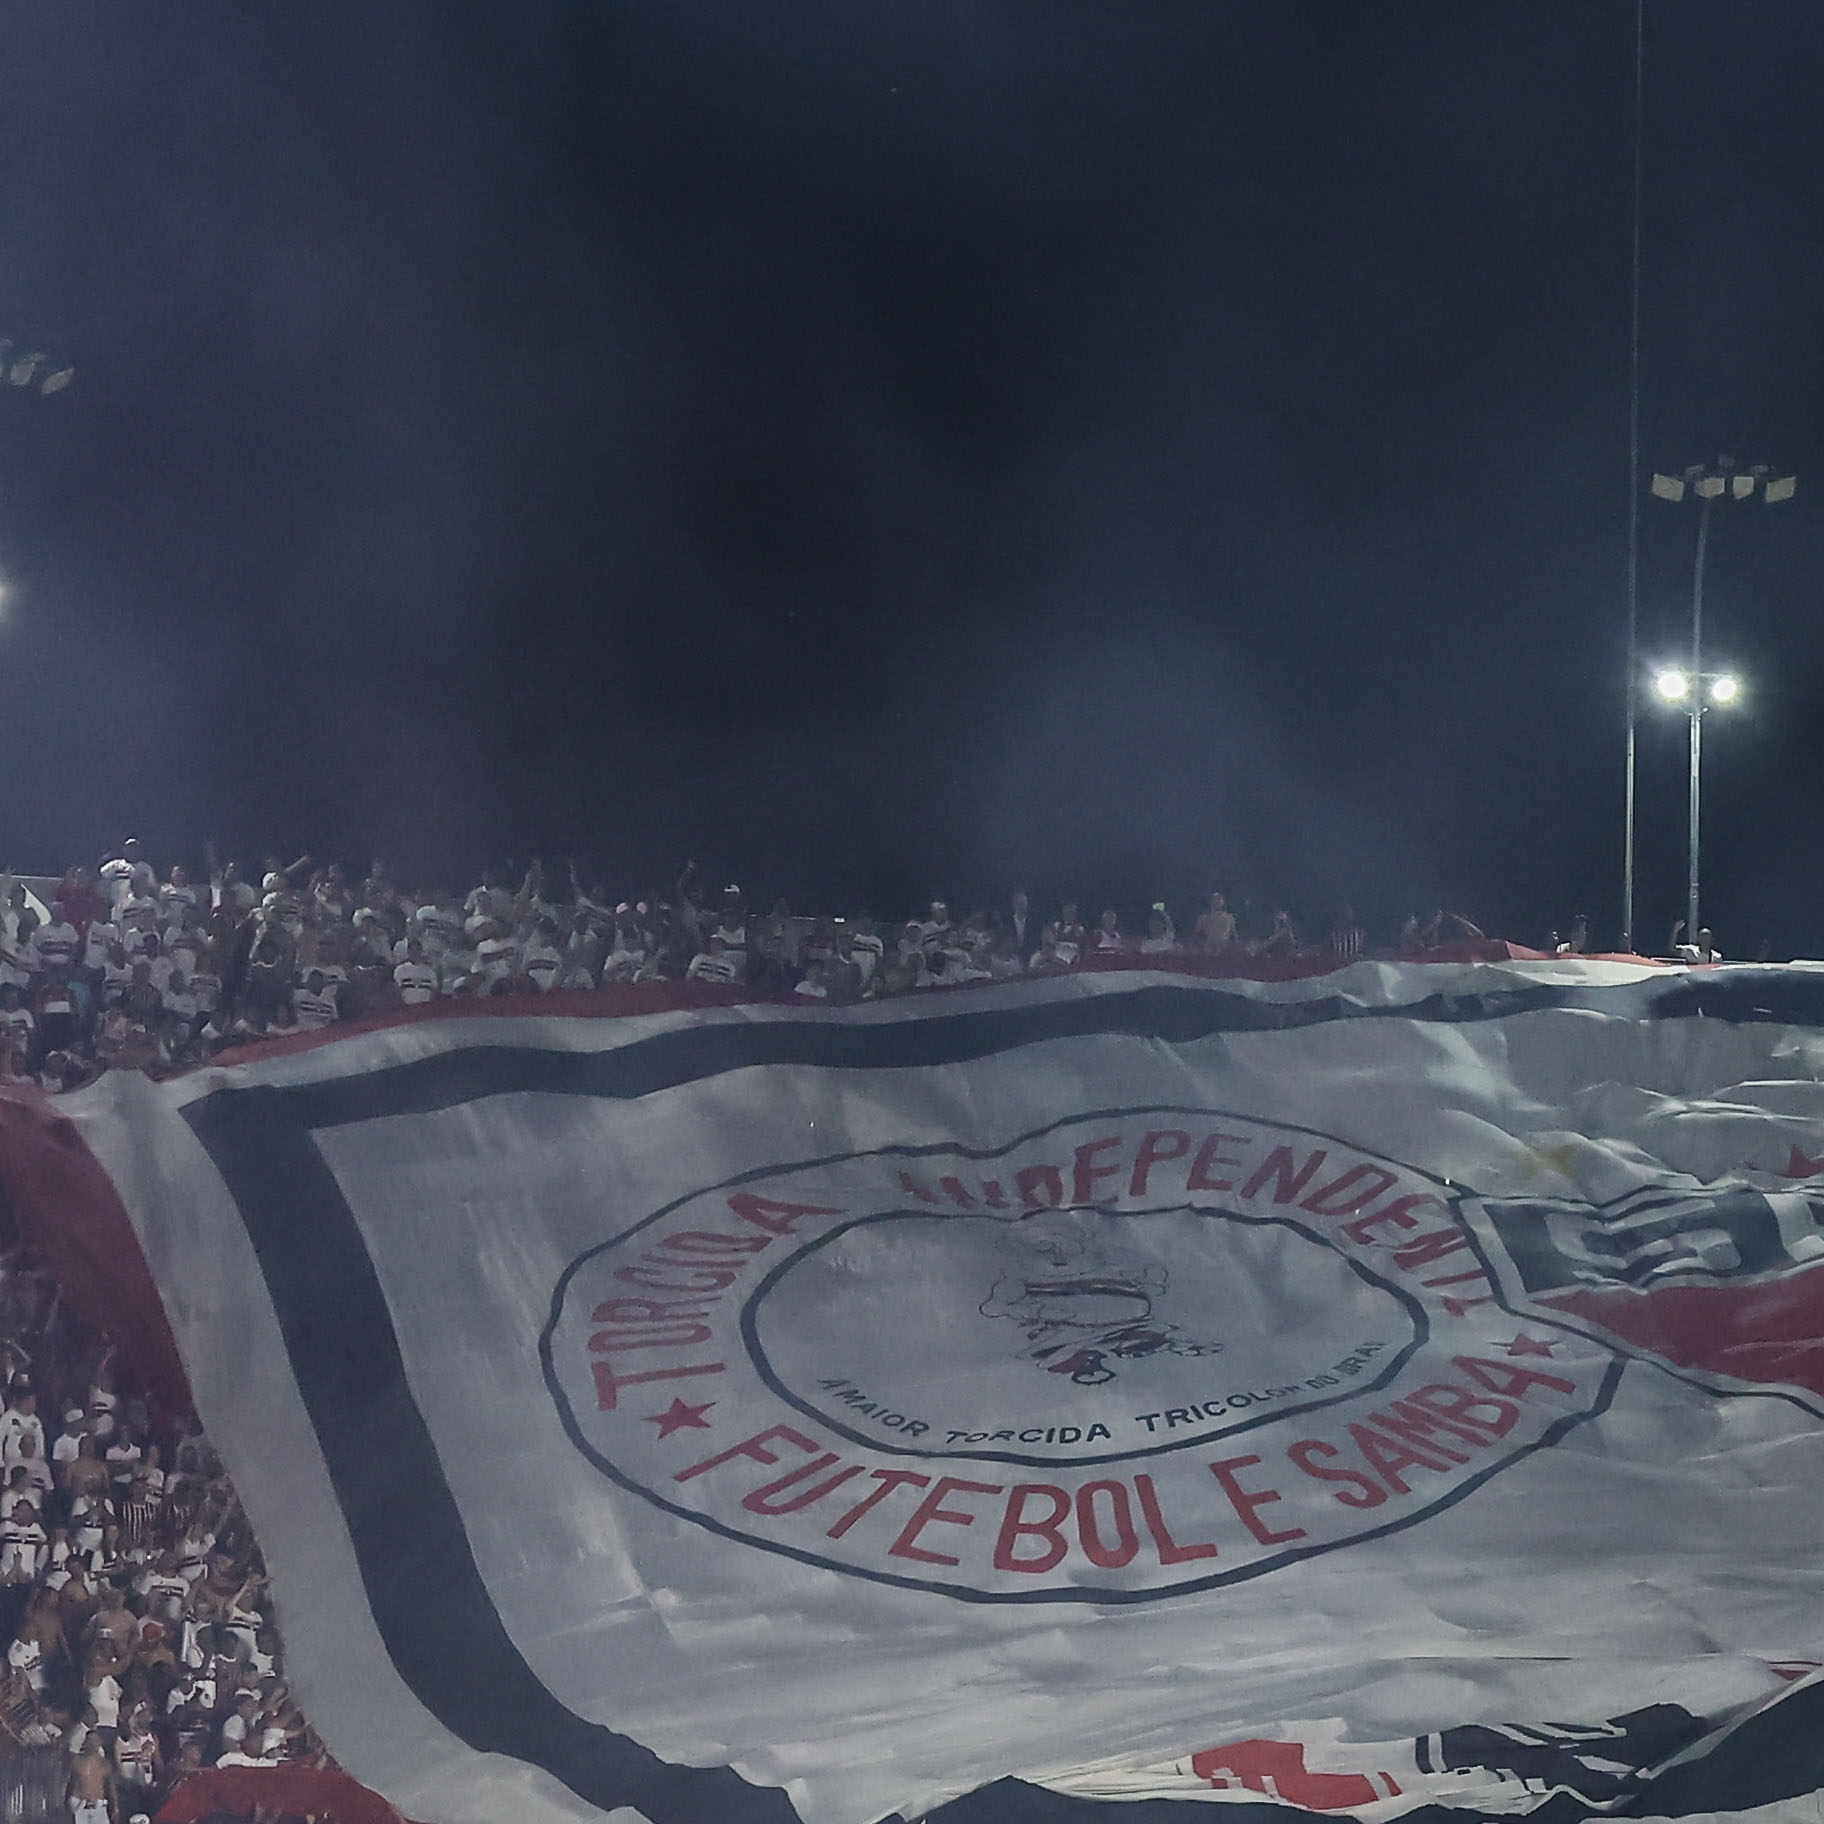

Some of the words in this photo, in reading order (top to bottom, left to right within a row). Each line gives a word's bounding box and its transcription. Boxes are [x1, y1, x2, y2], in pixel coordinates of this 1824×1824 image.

[588, 1193, 848, 1411] TORCIDA
[674, 1424, 1218, 1574] FUTEBOL
[1206, 1454, 1307, 1546] E
[1287, 1354, 1578, 1508] SAMBA
[834, 1389, 930, 1438] MAIOR
[944, 1423, 1112, 1445] TORCIDA
